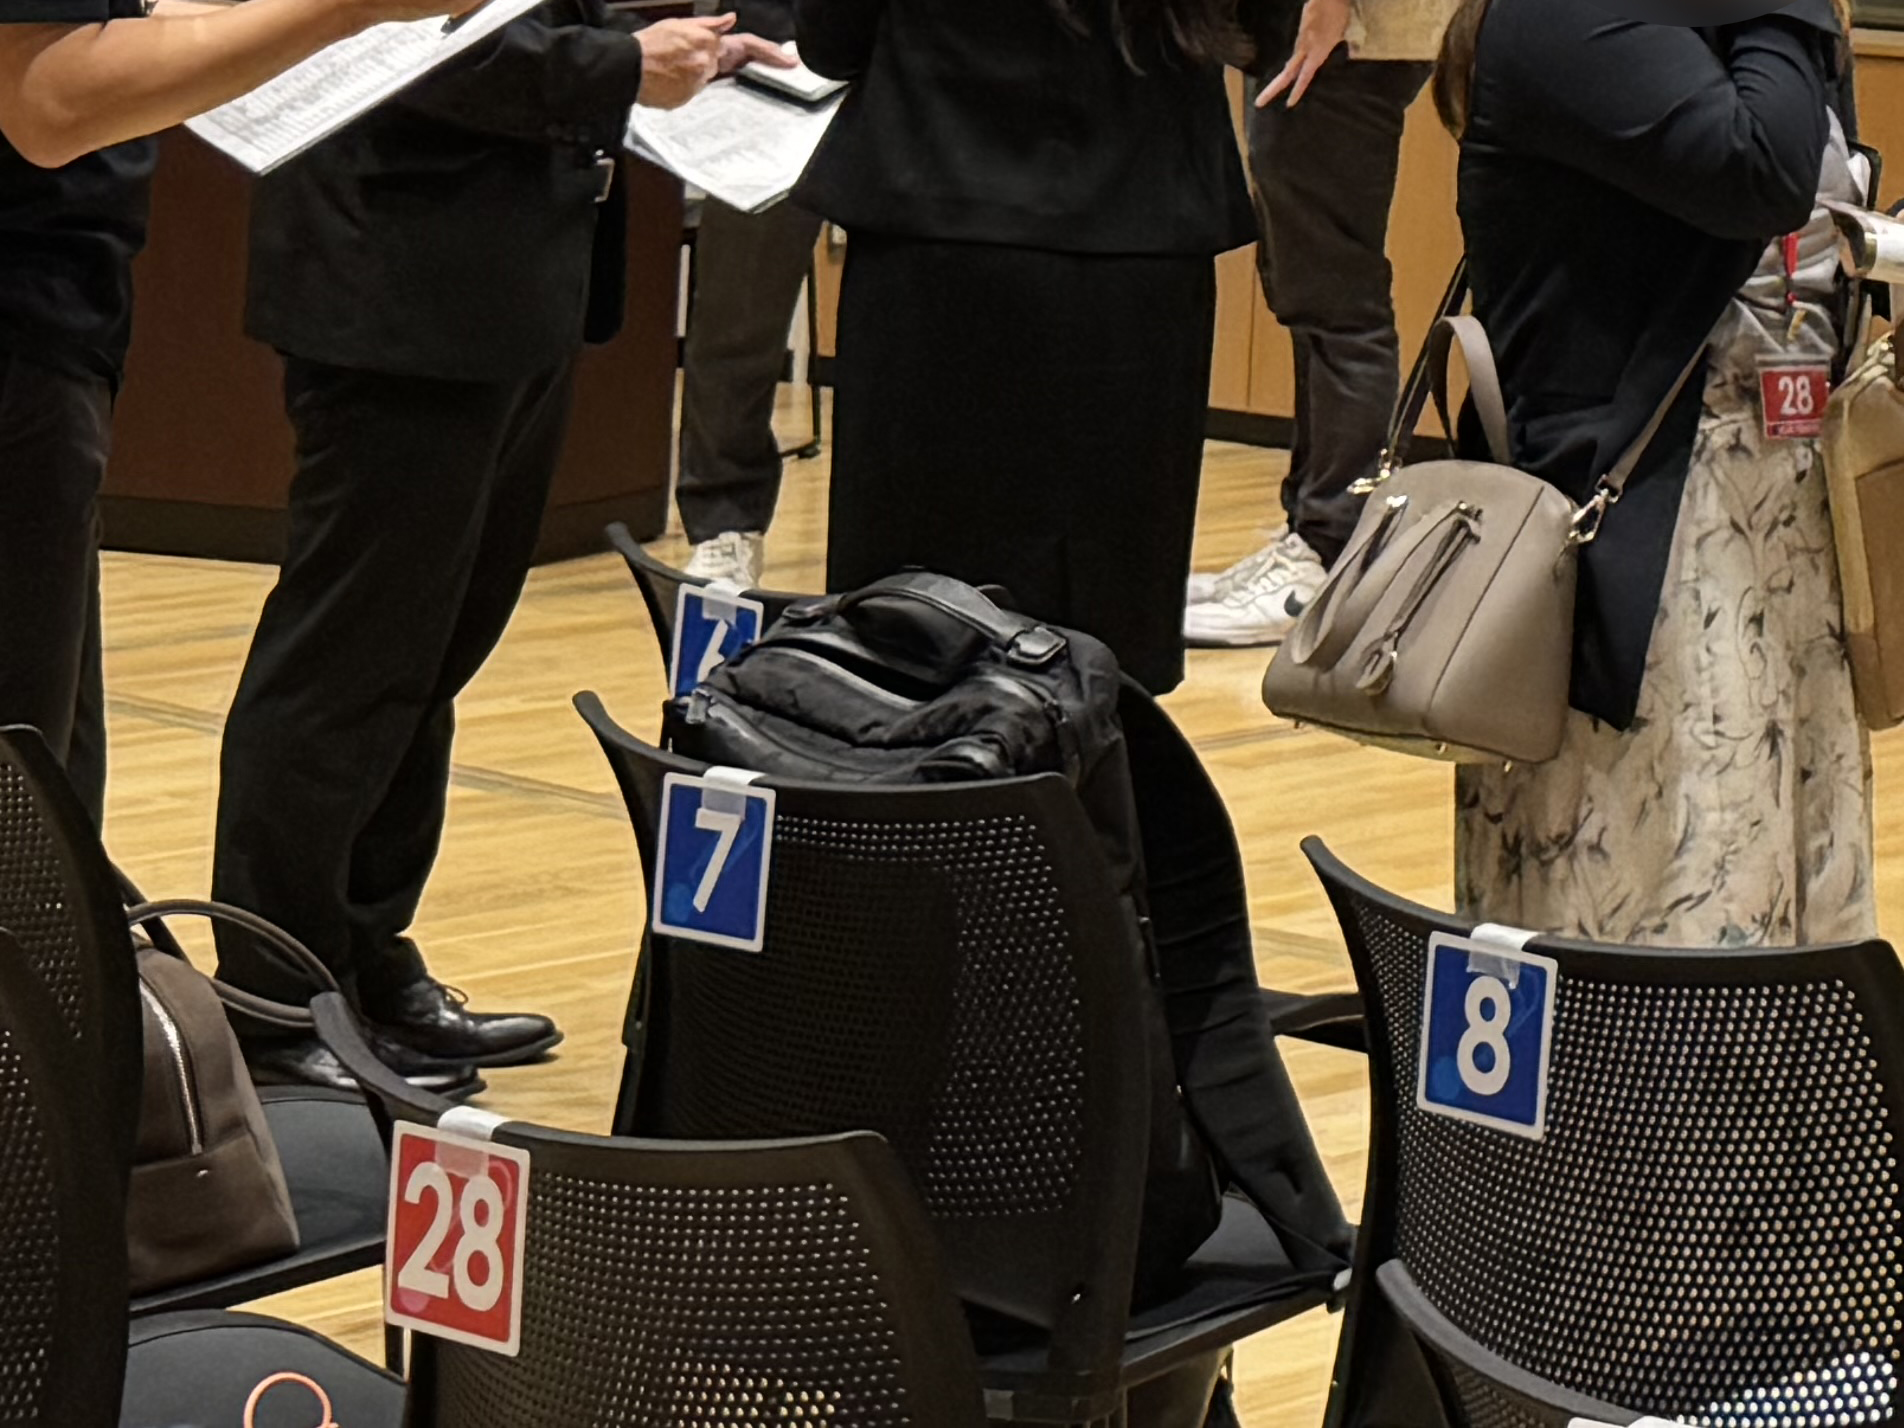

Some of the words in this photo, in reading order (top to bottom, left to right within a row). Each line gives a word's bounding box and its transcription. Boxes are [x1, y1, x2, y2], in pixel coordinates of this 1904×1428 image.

[1778, 375, 1814, 415] 28
[693, 808, 745, 913] 7
[1456, 974, 1512, 1096] 8
[397, 1161, 505, 1313] 28
